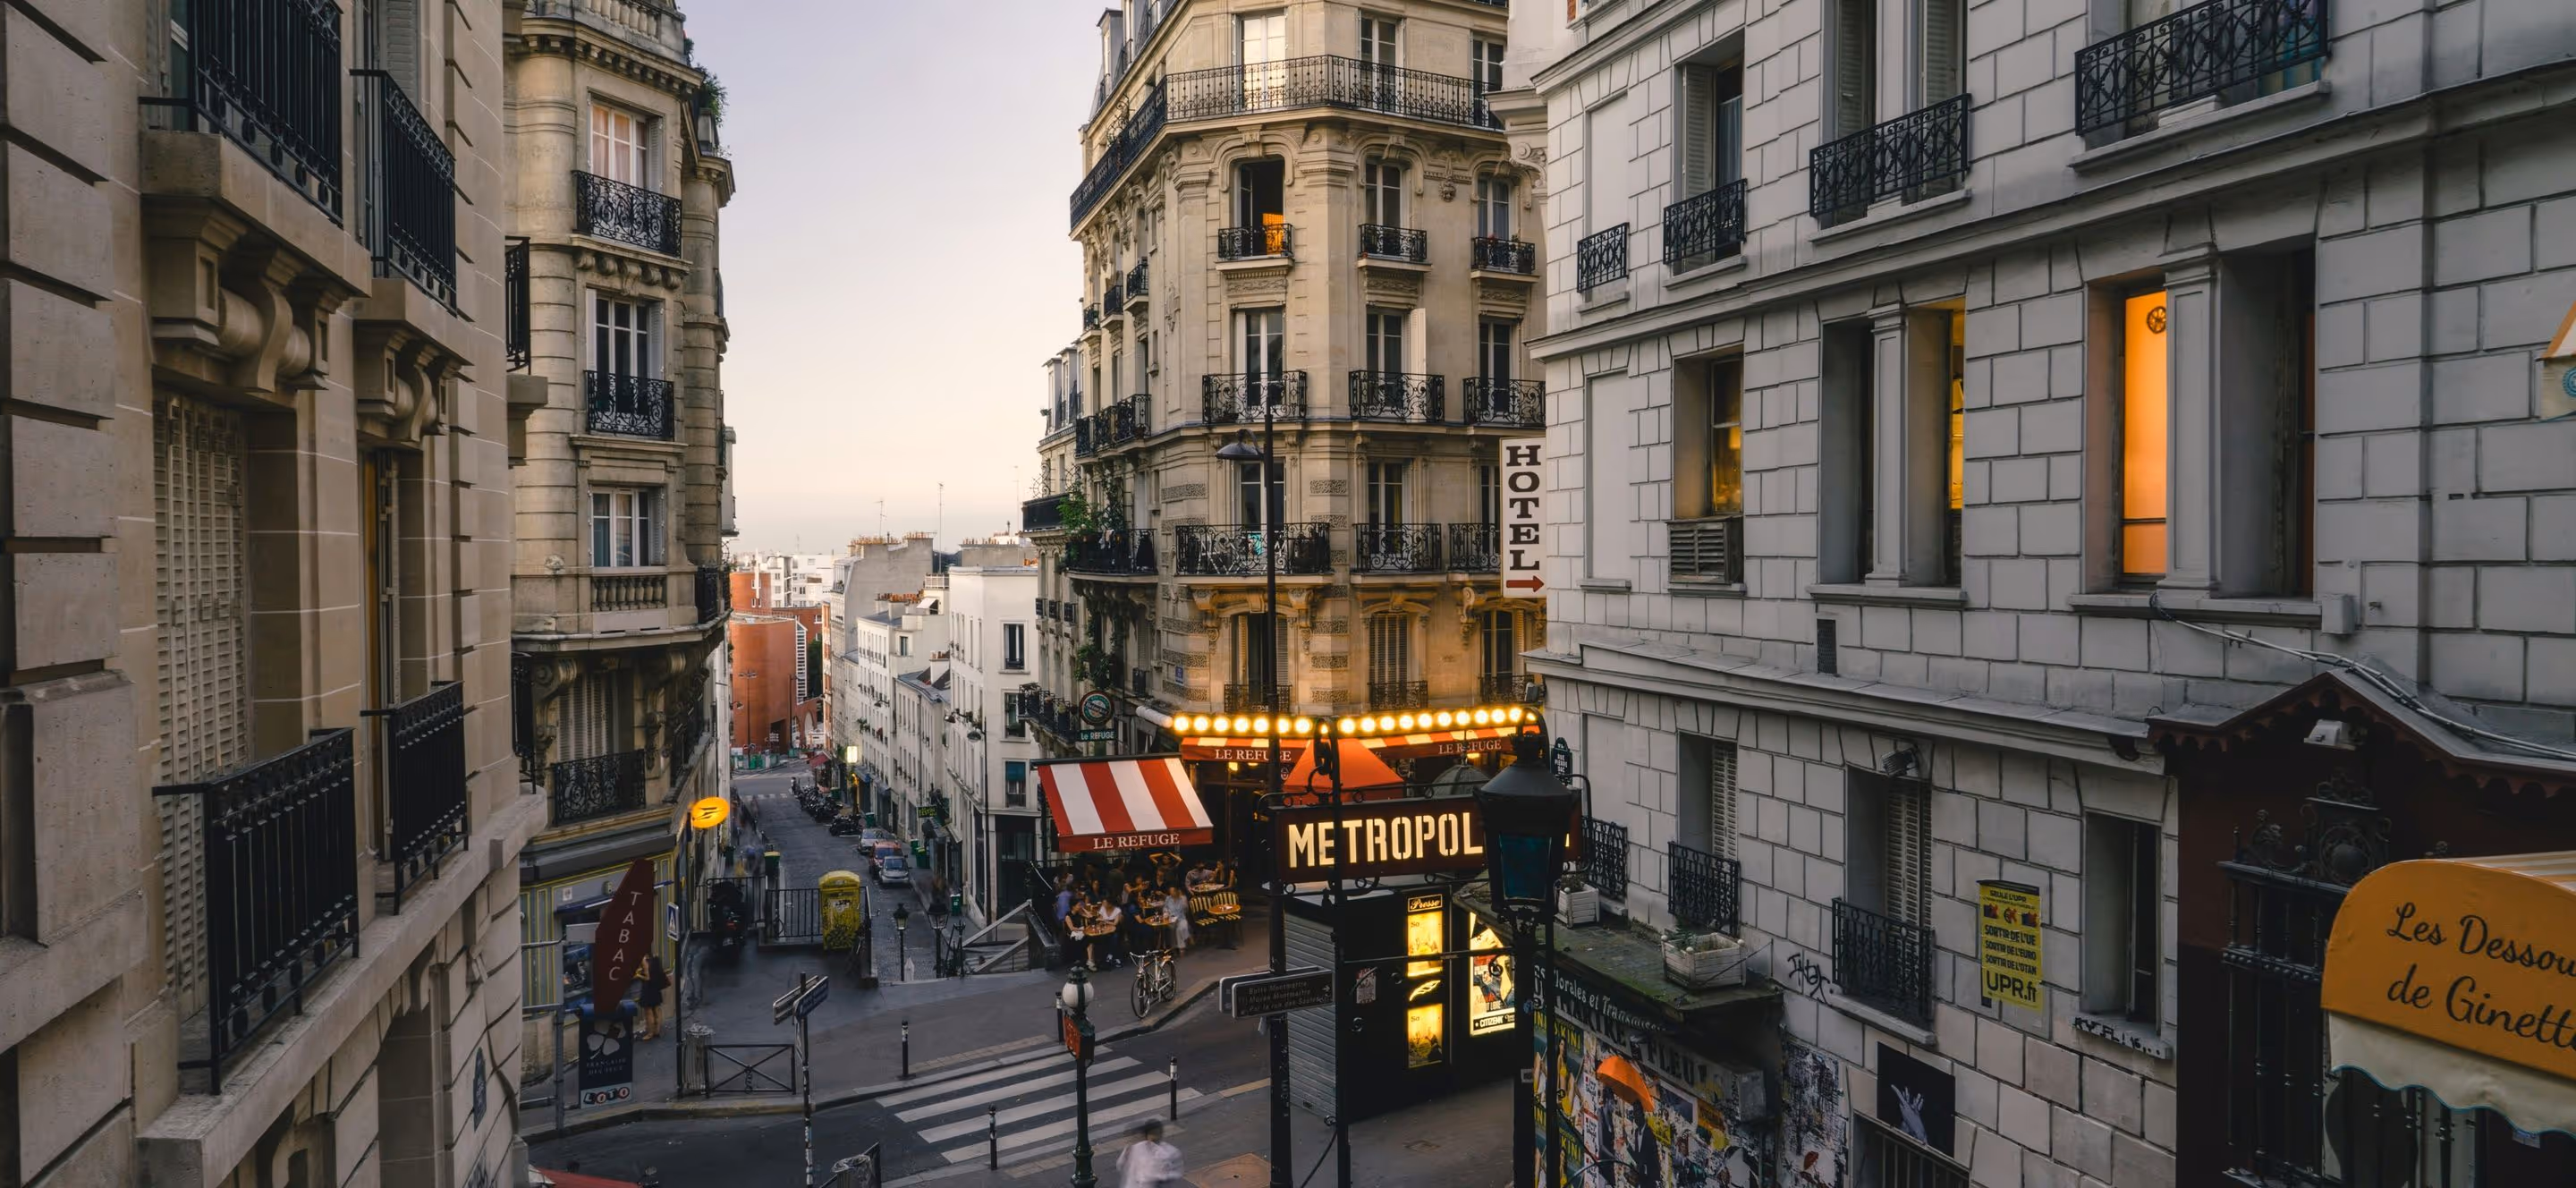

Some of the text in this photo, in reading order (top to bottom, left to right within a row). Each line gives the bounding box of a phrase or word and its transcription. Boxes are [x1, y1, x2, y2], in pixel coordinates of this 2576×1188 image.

[1506, 445, 1541, 571] HOTEL
[1080, 730, 1114, 741] Le REFUGE
[1215, 749, 1233, 759] LE
[1438, 739, 1502, 755] LE REFUGE
[1093, 833, 1181, 850] LE REFUGE
[1288, 811, 1484, 869] METROPOL
[1410, 898, 1440, 911] Presse
[609, 891, 642, 980] TABAC
[1985, 924, 2036, 946] SORTIR DE L'UE
[2386, 902, 2576, 977] Les Dessou
[1985, 940, 2006, 954] SORTIR
[2007, 945, 2015, 955] DE
[1985, 955, 2006, 968] SORTIR
[2007, 959, 2015, 970] DE
[1554, 968, 1587, 1004] lorales
[1589, 994, 1599, 1010] et
[1987, 969, 2037, 1003] UPR.fr
[2387, 963, 2433, 1009] de
[583, 1086, 631, 1105] LOTO
